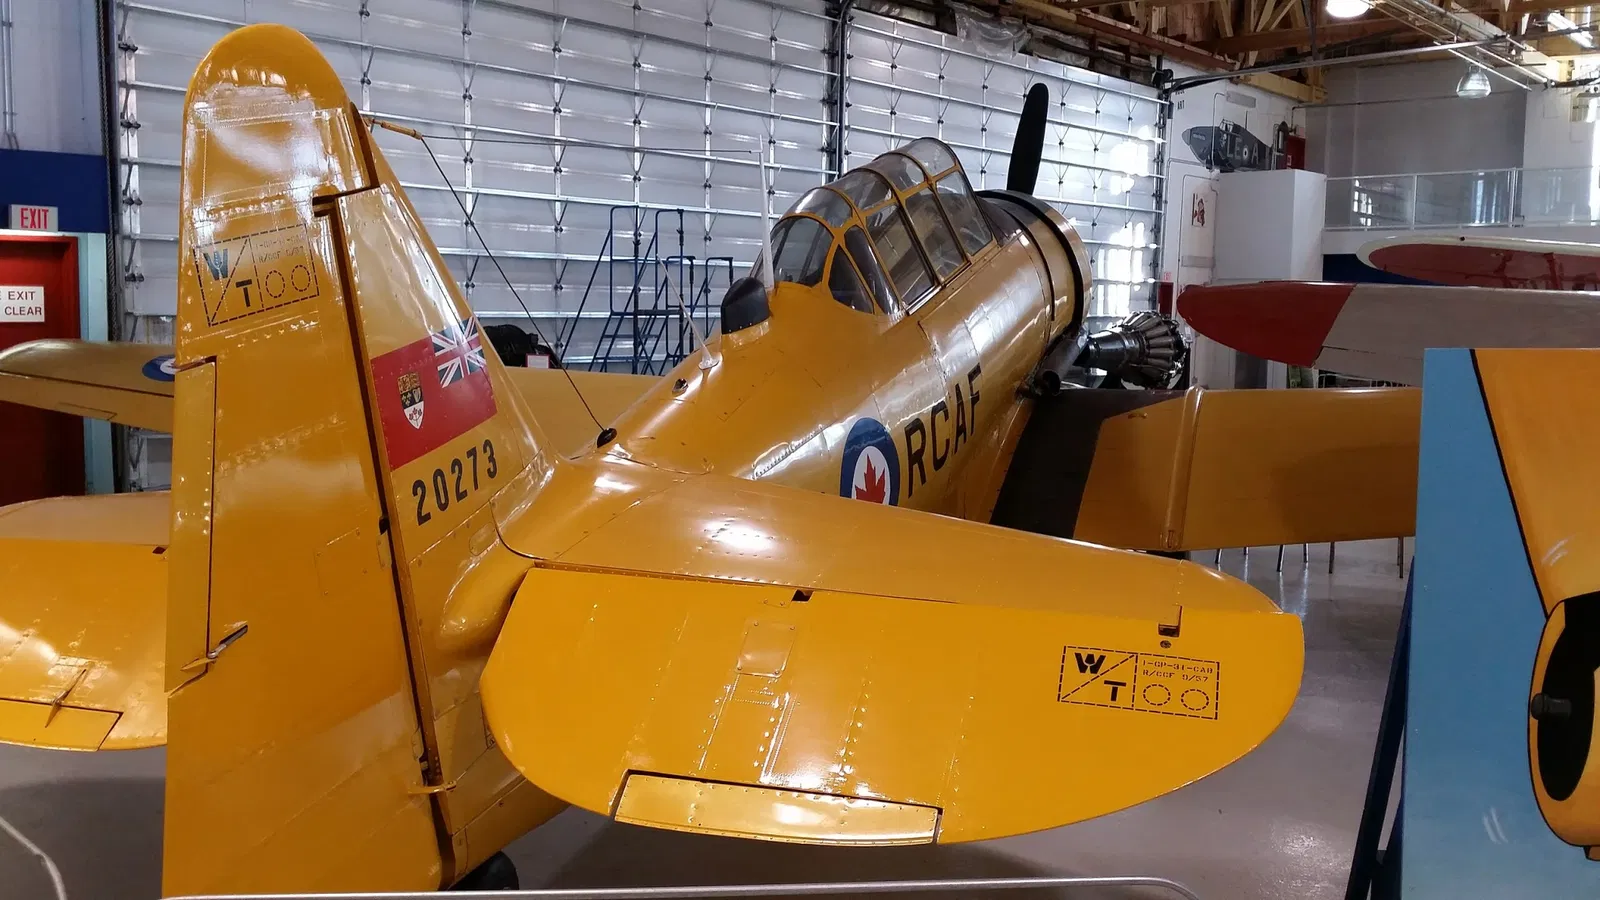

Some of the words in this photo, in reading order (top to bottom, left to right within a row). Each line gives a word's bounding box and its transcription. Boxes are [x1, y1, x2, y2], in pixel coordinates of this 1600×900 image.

[20, 207, 49, 229] EXIT
[203, 248, 228, 281] W
[8, 291, 36, 301] EXIT
[235, 279, 253, 307] T
[4, 306, 42, 316] CLEAR
[904, 362, 981, 499] RCAF
[412, 439, 498, 526] 20273
[1074, 652, 1107, 675] W
[1103, 680, 1127, 702] T
